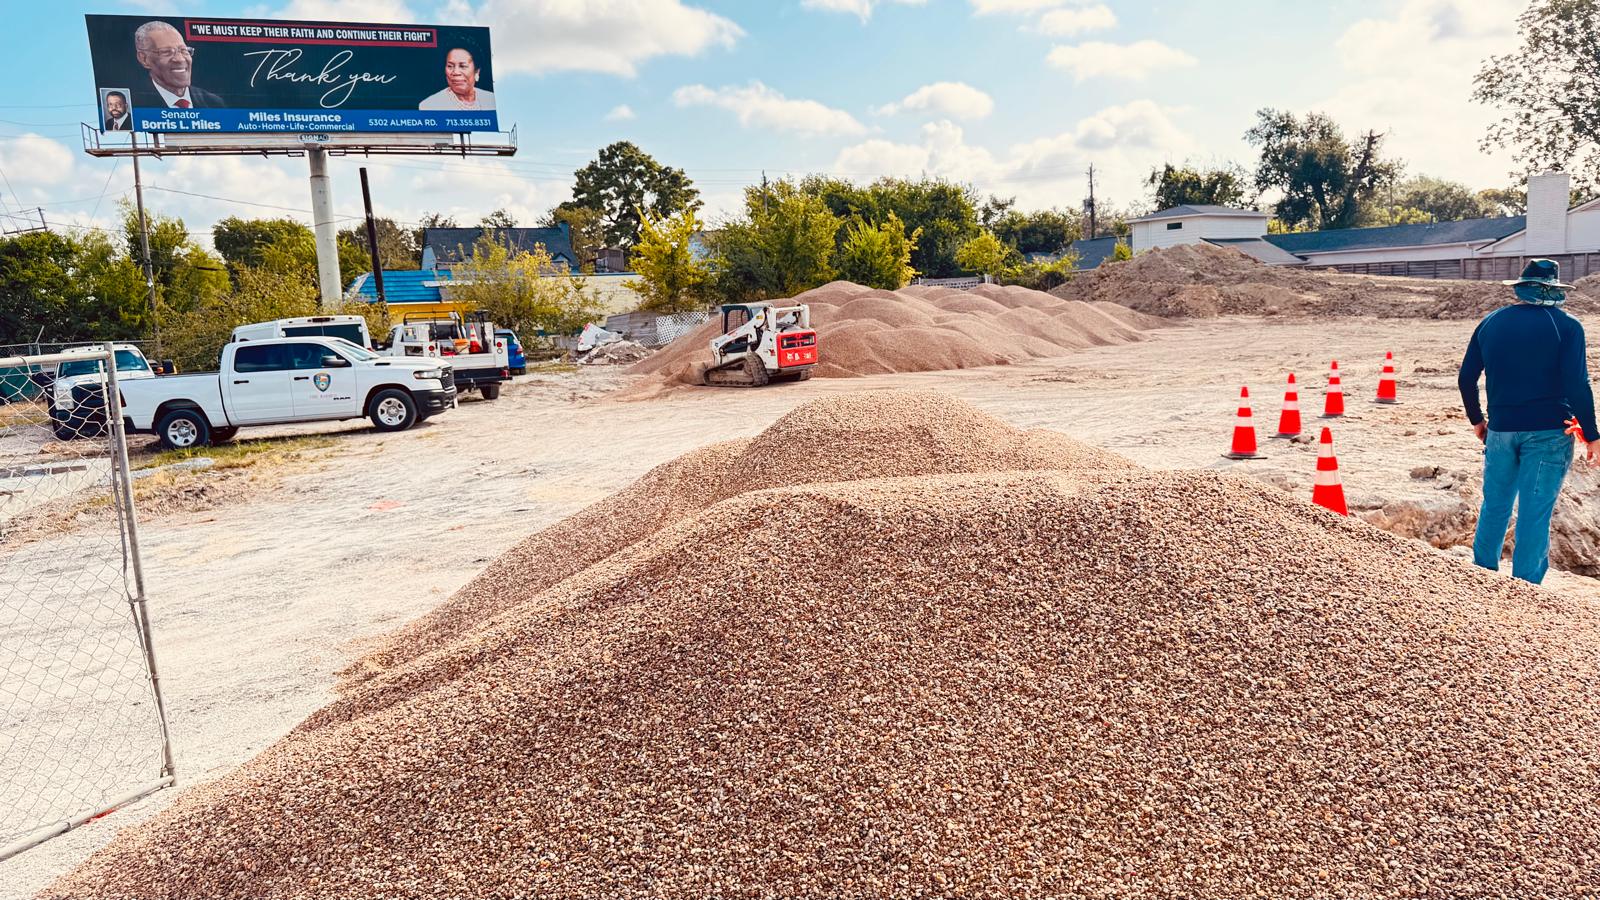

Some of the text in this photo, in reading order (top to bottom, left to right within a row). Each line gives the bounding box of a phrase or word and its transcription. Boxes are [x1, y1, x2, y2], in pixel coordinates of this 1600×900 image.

[212, 26, 238, 36] MUST
[240, 26, 262, 36] KEEP
[264, 27, 289, 37] THEIR
[291, 28, 314, 38] FAITH
[316, 29, 334, 38] AND
[336, 30, 377, 40] CONTINUE
[378, 31, 402, 40] THEIR
[404, 32, 430, 41] FIGHT"
[244, 48, 397, 108] Thank you
[161, 110, 200, 119] Senator
[249, 112, 341, 122] Miles Insurance
[142, 120, 221, 130] Borris L. Miles
[368, 118, 388, 126] 5302
[445, 119, 491, 127] 713.355.8331
